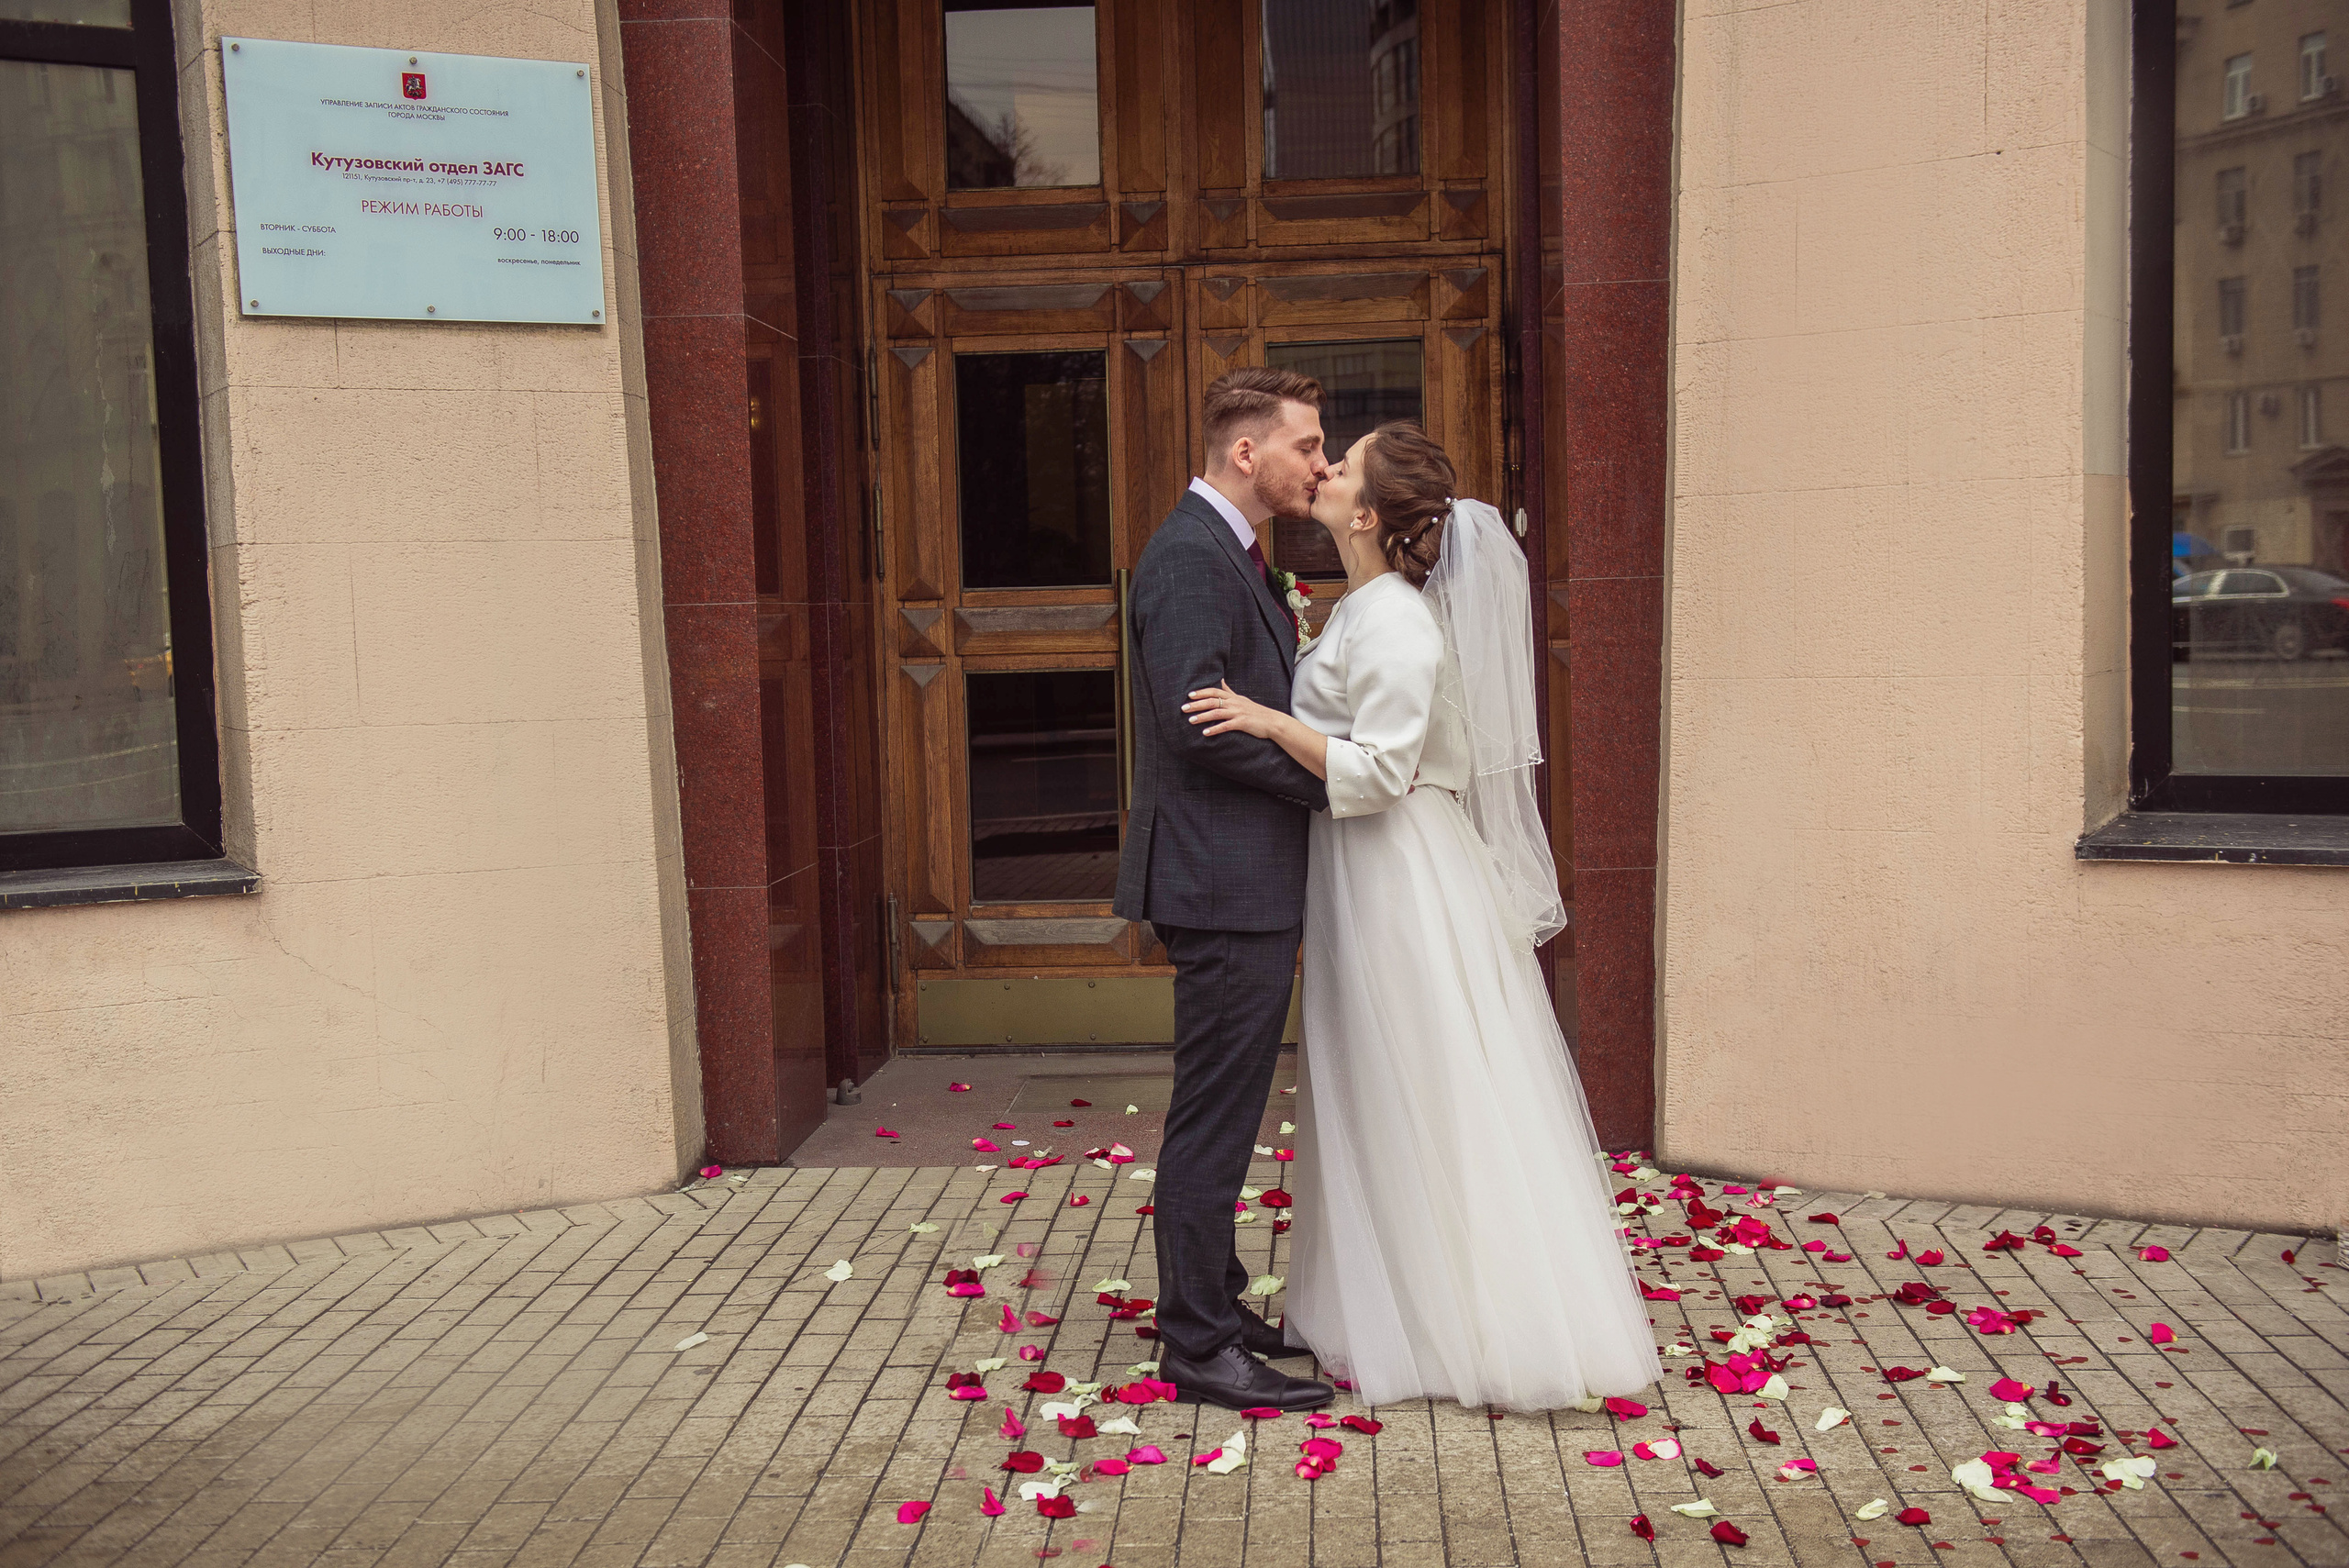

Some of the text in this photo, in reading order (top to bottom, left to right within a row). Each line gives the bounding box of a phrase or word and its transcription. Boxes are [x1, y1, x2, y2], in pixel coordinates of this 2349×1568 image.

[319, 98, 363, 108] УПРАВЛЕНИЕ
[394, 103, 416, 111] АКТОВ
[416, 105, 468, 115] ГРАЖДАНСКОГО
[469, 108, 509, 117] СОСТОЯНИЯ
[388, 111, 446, 121] ГОРОДА МОСКВЫ
[311, 151, 525, 177] Кутузовский отдел ЗАГС
[342, 172, 363, 181] 121151,
[364, 173, 402, 182] Кутузовский
[447, 178, 463, 186] (495)
[464, 179, 497, 187] 777-77-77
[362, 199, 484, 217] РЕЖИМ РАБОТЫ
[260, 223, 296, 232] ВТОРНИК
[302, 225, 337, 234] СУББОТА
[493, 228, 527, 241] 9:00
[541, 229, 580, 243] 18:00
[262, 247, 327, 257] ВЫХОДНЫЕ ДНИ:
